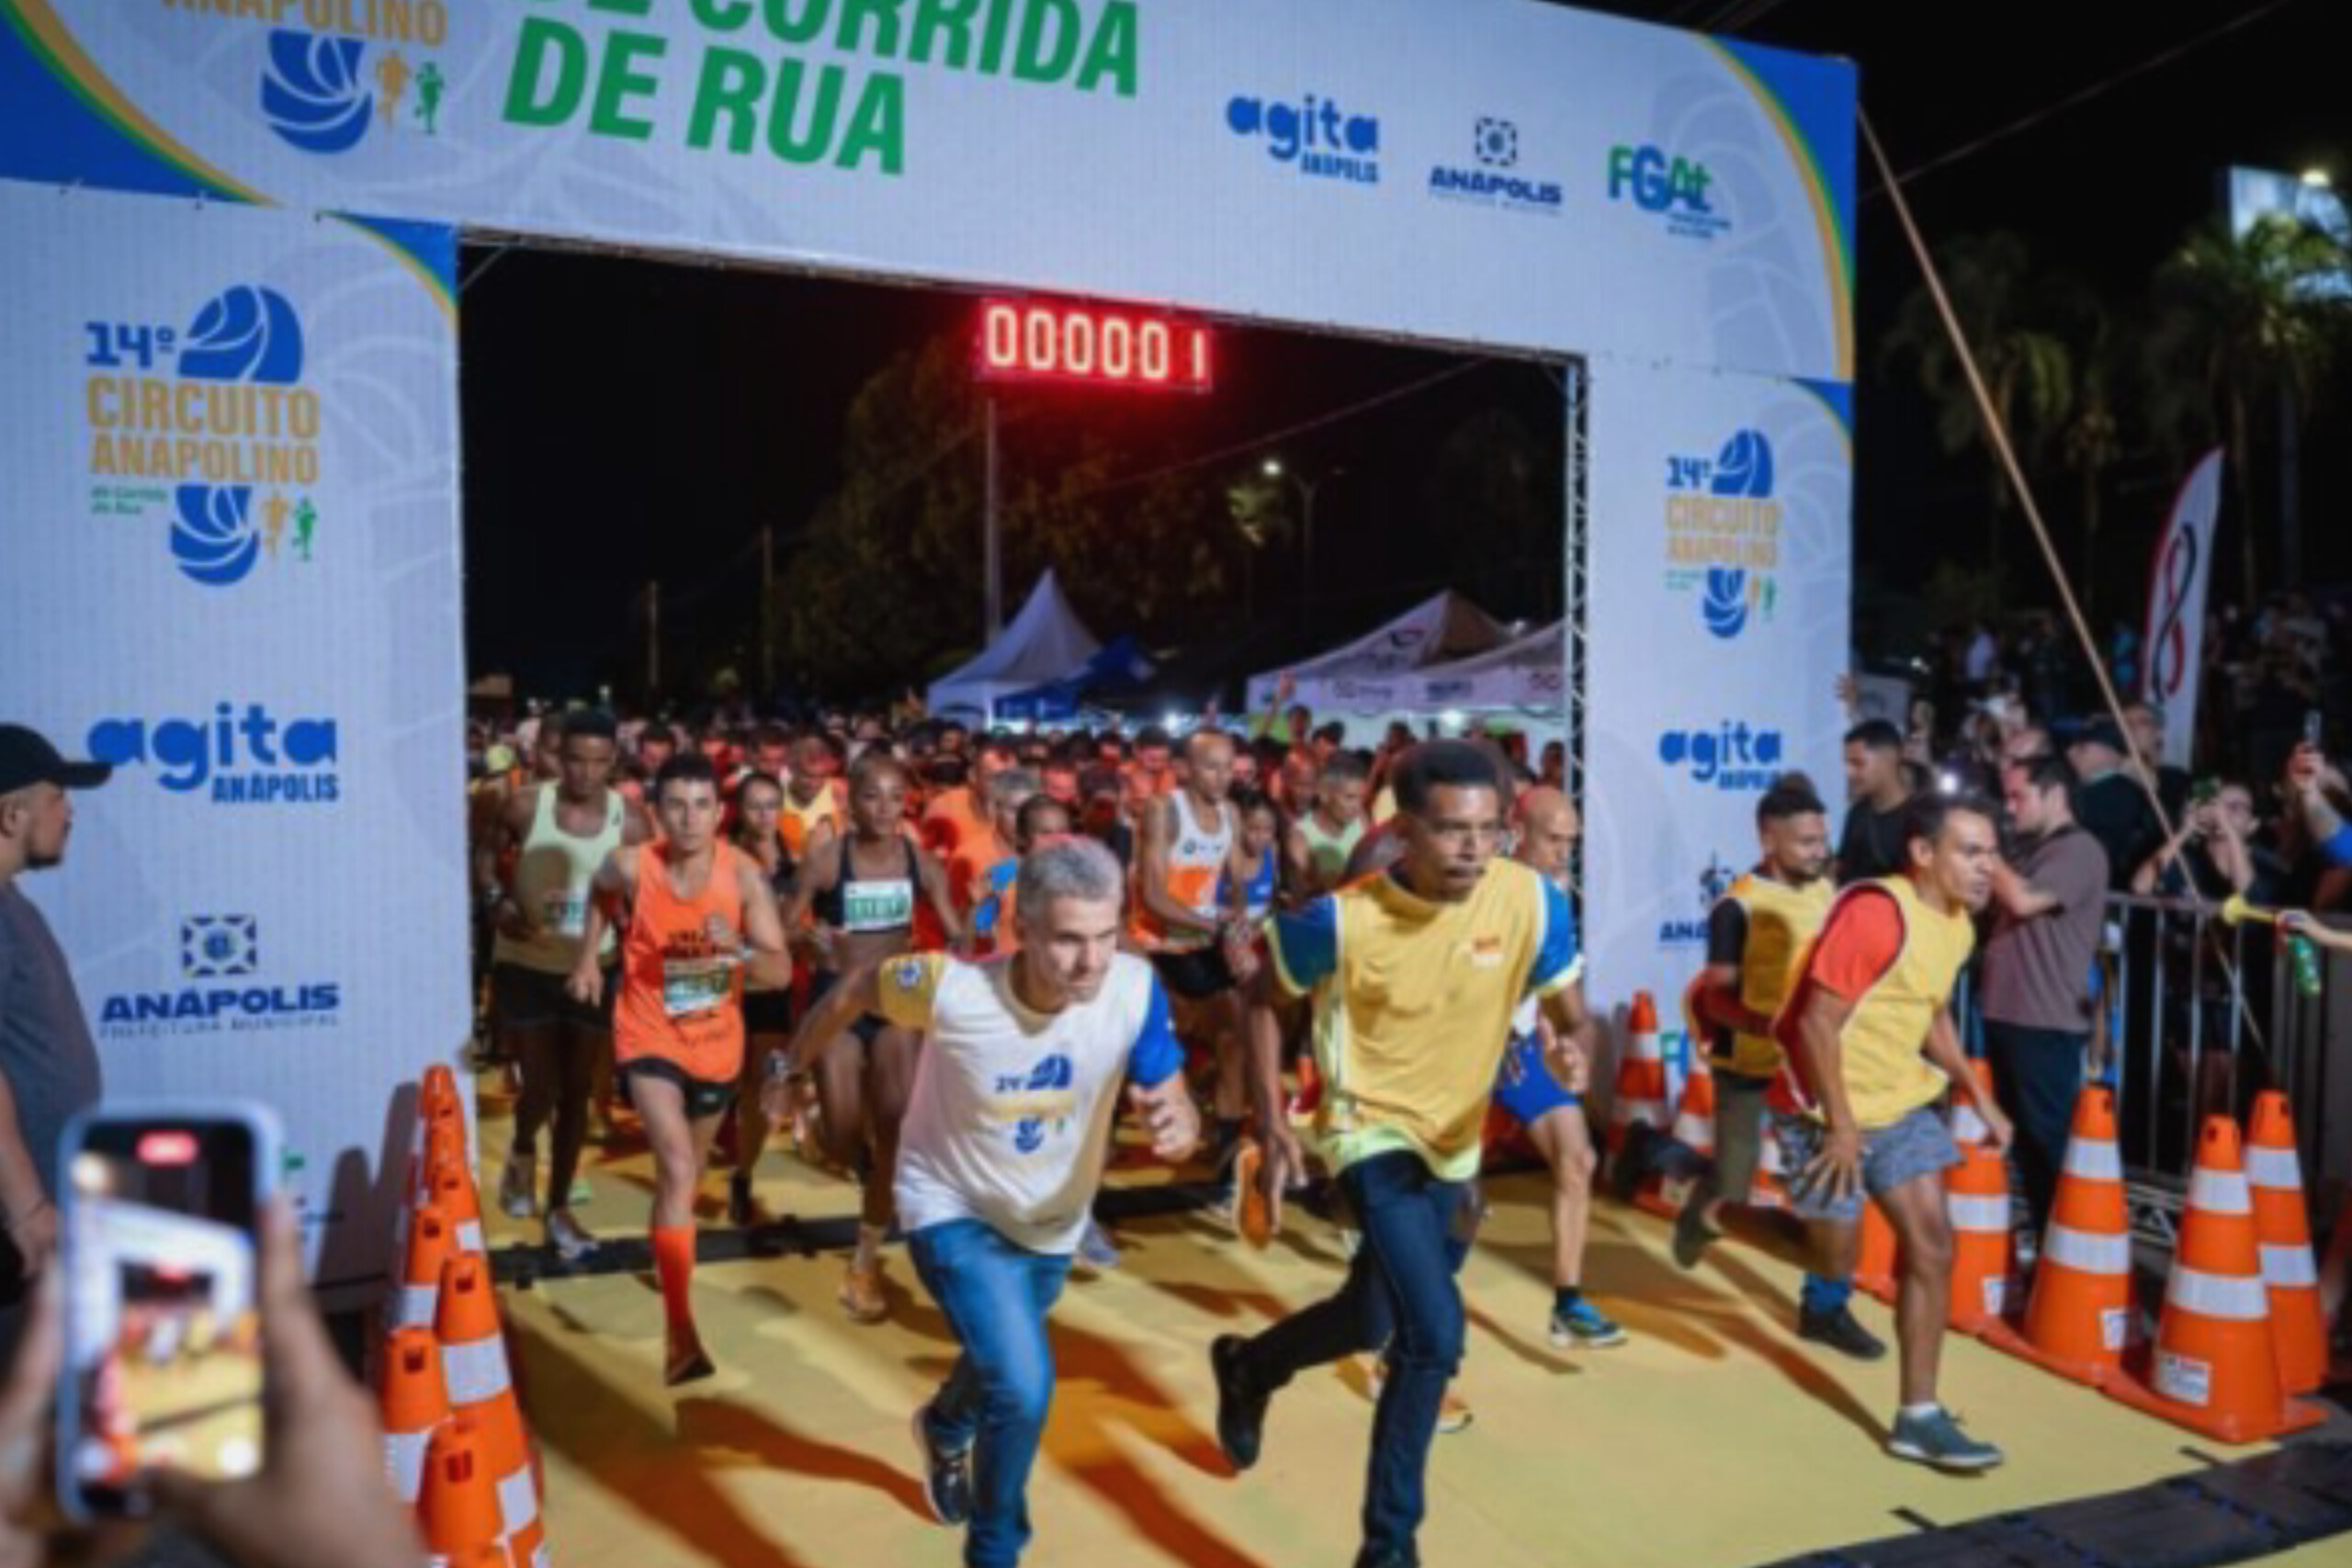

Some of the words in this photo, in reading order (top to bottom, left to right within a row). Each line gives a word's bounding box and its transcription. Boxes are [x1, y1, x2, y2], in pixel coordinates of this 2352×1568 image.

[502, 16, 669, 141] DE
[685, 45, 904, 176] RUA
[1227, 95, 1378, 163] agita
[87, 377, 321, 439] CIRCUITO
[89, 434, 320, 483] ANAPOLINO
[86, 701, 337, 791] agita
[1658, 719, 1781, 782] agita
